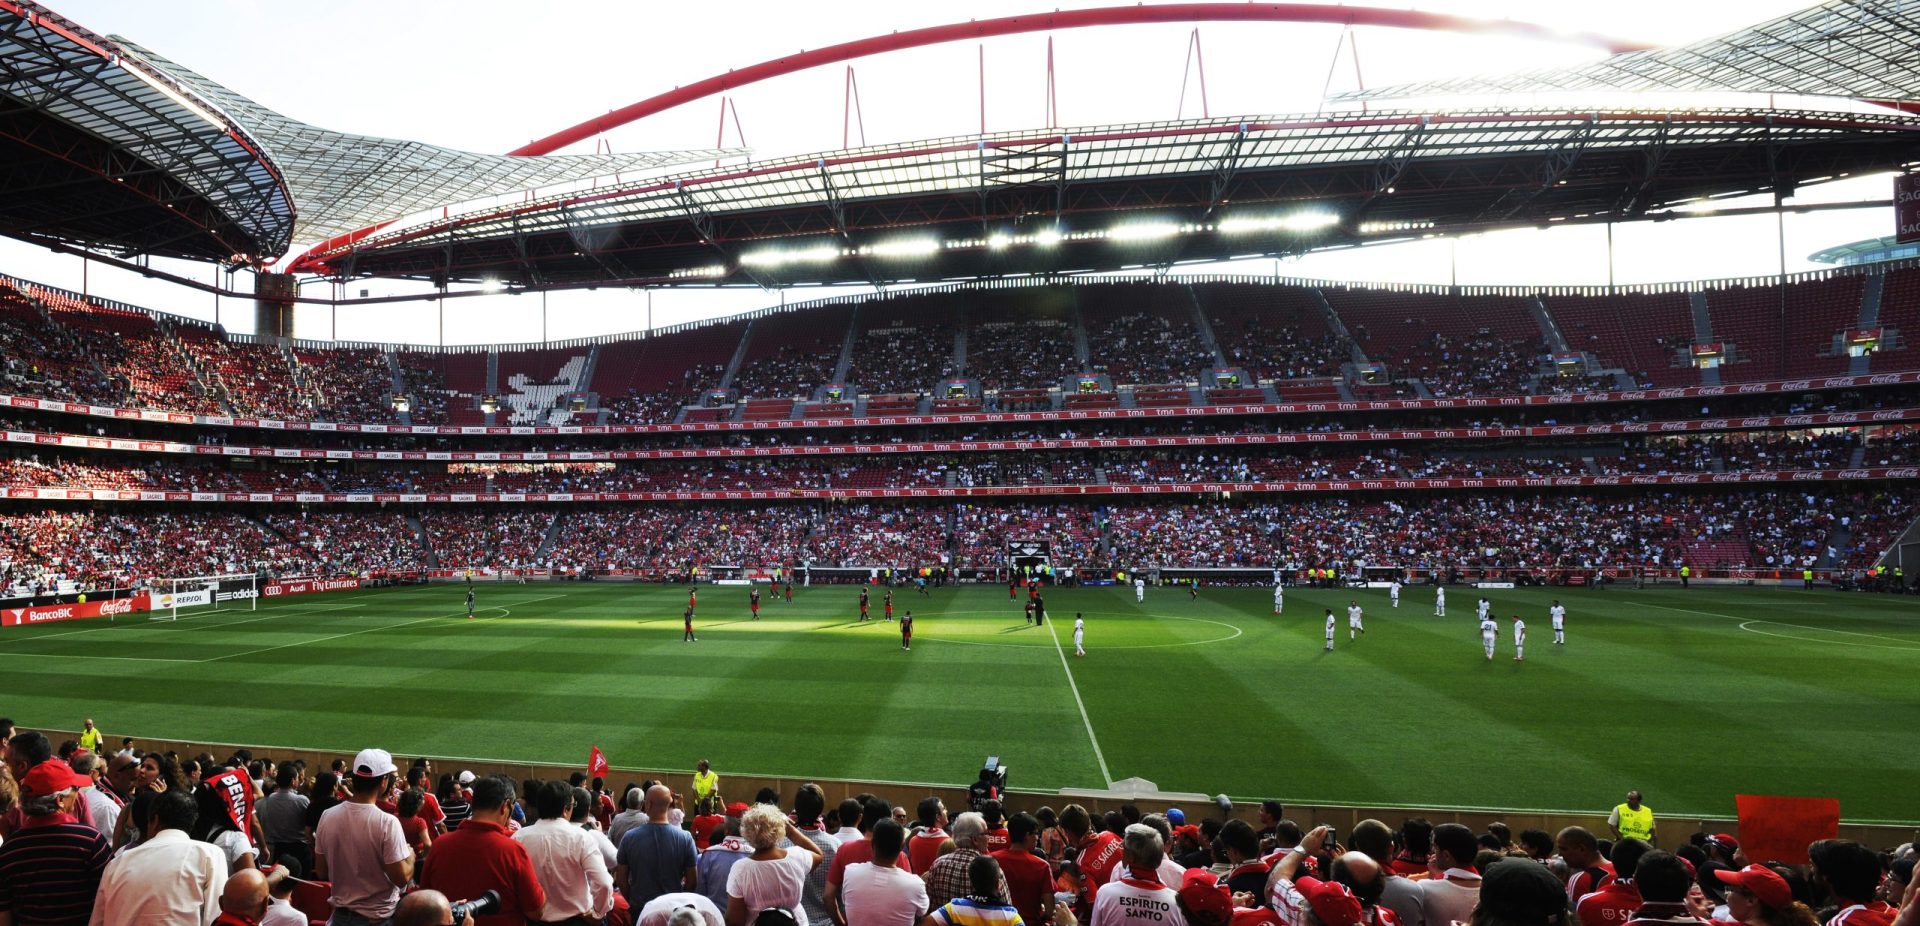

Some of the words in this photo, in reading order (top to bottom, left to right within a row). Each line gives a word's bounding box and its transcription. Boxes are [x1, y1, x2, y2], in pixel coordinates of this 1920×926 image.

[778, 420, 792, 428] tmn
[828, 418, 843, 426] tmn
[880, 417, 895, 425] tmn
[932, 415, 948, 423] tmn
[1014, 413, 1030, 421] tmn
[1069, 411, 1087, 419] tmn
[1127, 409, 1144, 417] tmn
[1186, 407, 1203, 415] tmn
[1246, 405, 1263, 413] tmn
[1307, 403, 1325, 411] tmn
[1369, 402, 1388, 410] tmn
[1434, 399, 1453, 407] tmn
[804, 446, 819, 454] tmn
[855, 445, 870, 453] tmn
[908, 444, 923, 452] tmn
[934, 443, 950, 451] tmn
[988, 442, 1004, 450] tmn
[1100, 439, 1117, 447] tmn
[1158, 437, 1175, 445] tmn
[1217, 436, 1235, 444] tmn
[1277, 435, 1295, 443] tmn
[1338, 433, 1357, 441] tmn
[1402, 430, 1422, 439] tmn
[1434, 429, 1454, 437] tmn
[1172, 484, 1190, 492] tmn
[1234, 483, 1252, 491] tmn
[1297, 482, 1316, 490] tmn
[1362, 481, 1382, 489] tmn
[1428, 480, 1448, 488] tmn
[1496, 479, 1517, 487] tmn
[1525, 478, 1545, 486] tmn
[830, 489, 845, 498] tmn
[883, 488, 899, 497] tmn
[910, 488, 927, 496] tmn
[290, 585, 306, 593] Audi
[312, 581, 324, 592] Fly
[325, 579, 357, 589] Emirates
[176, 595, 202, 604] REPSOL
[100, 598, 133, 615] Coca-Cola
[30, 608, 73, 620] BancoBIC
[1125, 908, 1162, 921] SANTO
